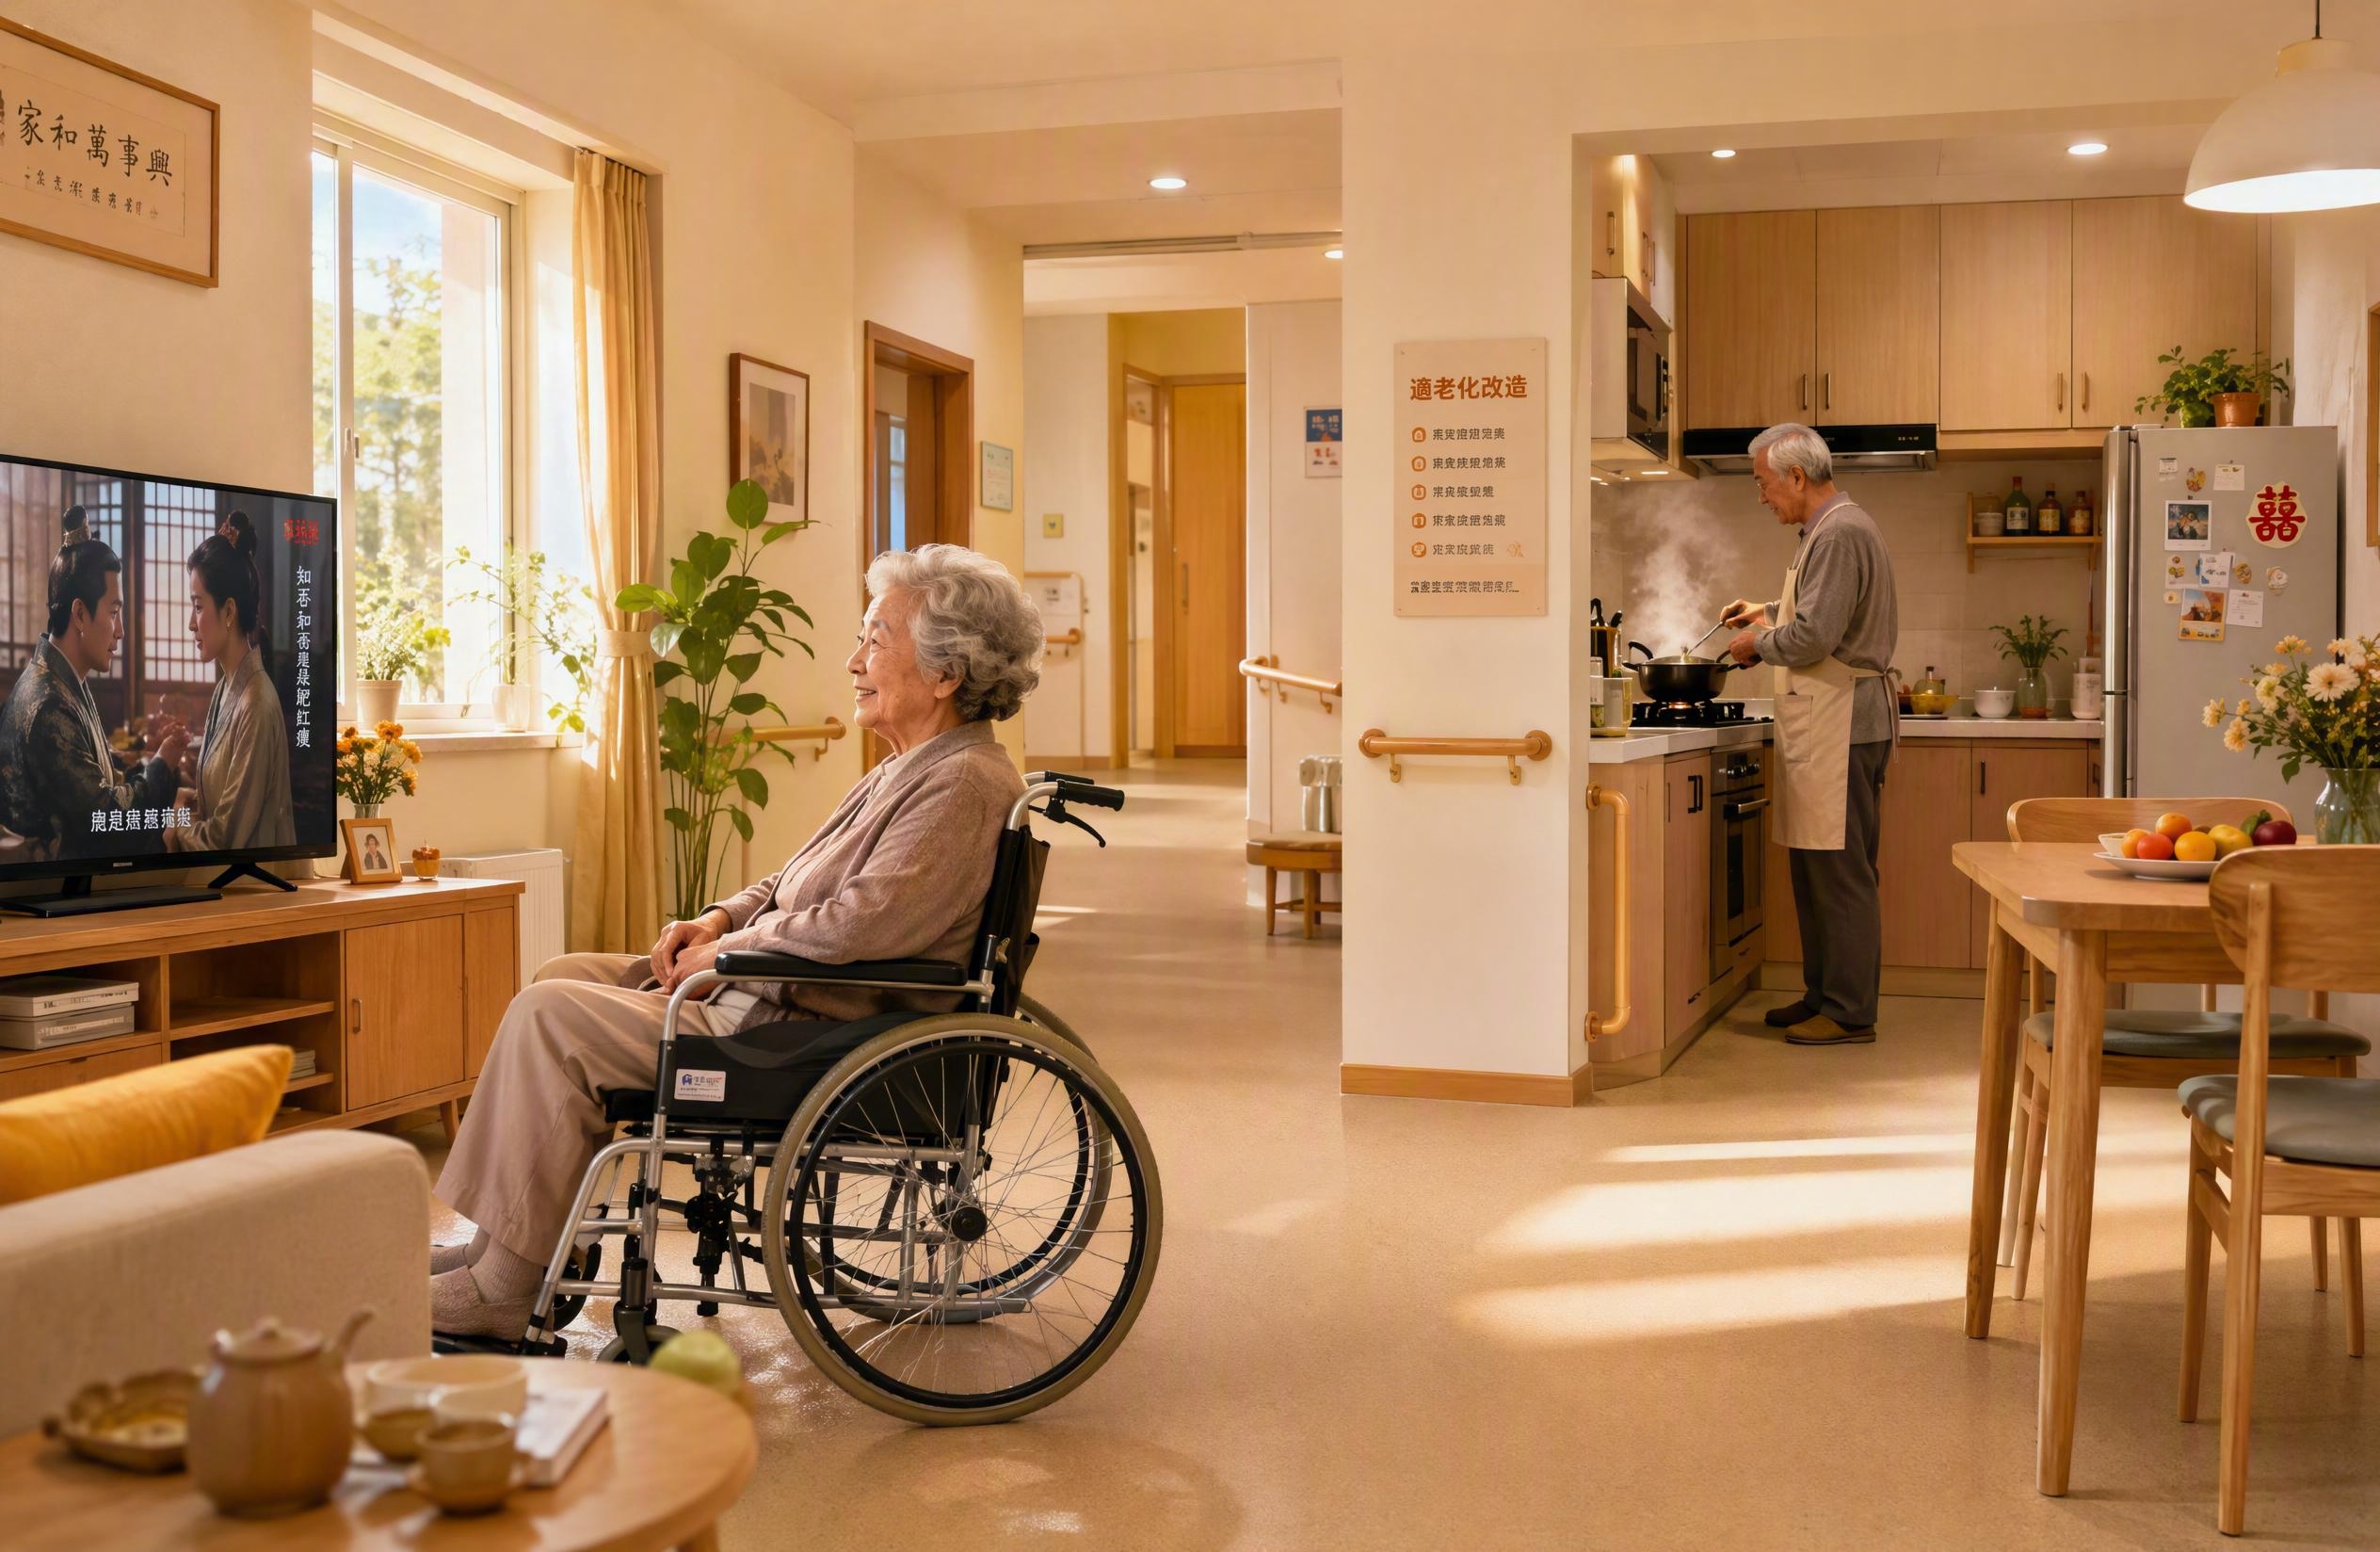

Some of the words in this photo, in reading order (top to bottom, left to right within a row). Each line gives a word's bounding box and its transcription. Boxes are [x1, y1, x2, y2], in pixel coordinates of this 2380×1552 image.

[18, 99, 172, 186] 家和萬事興
[1410, 375, 1528, 401] 適老化改造
